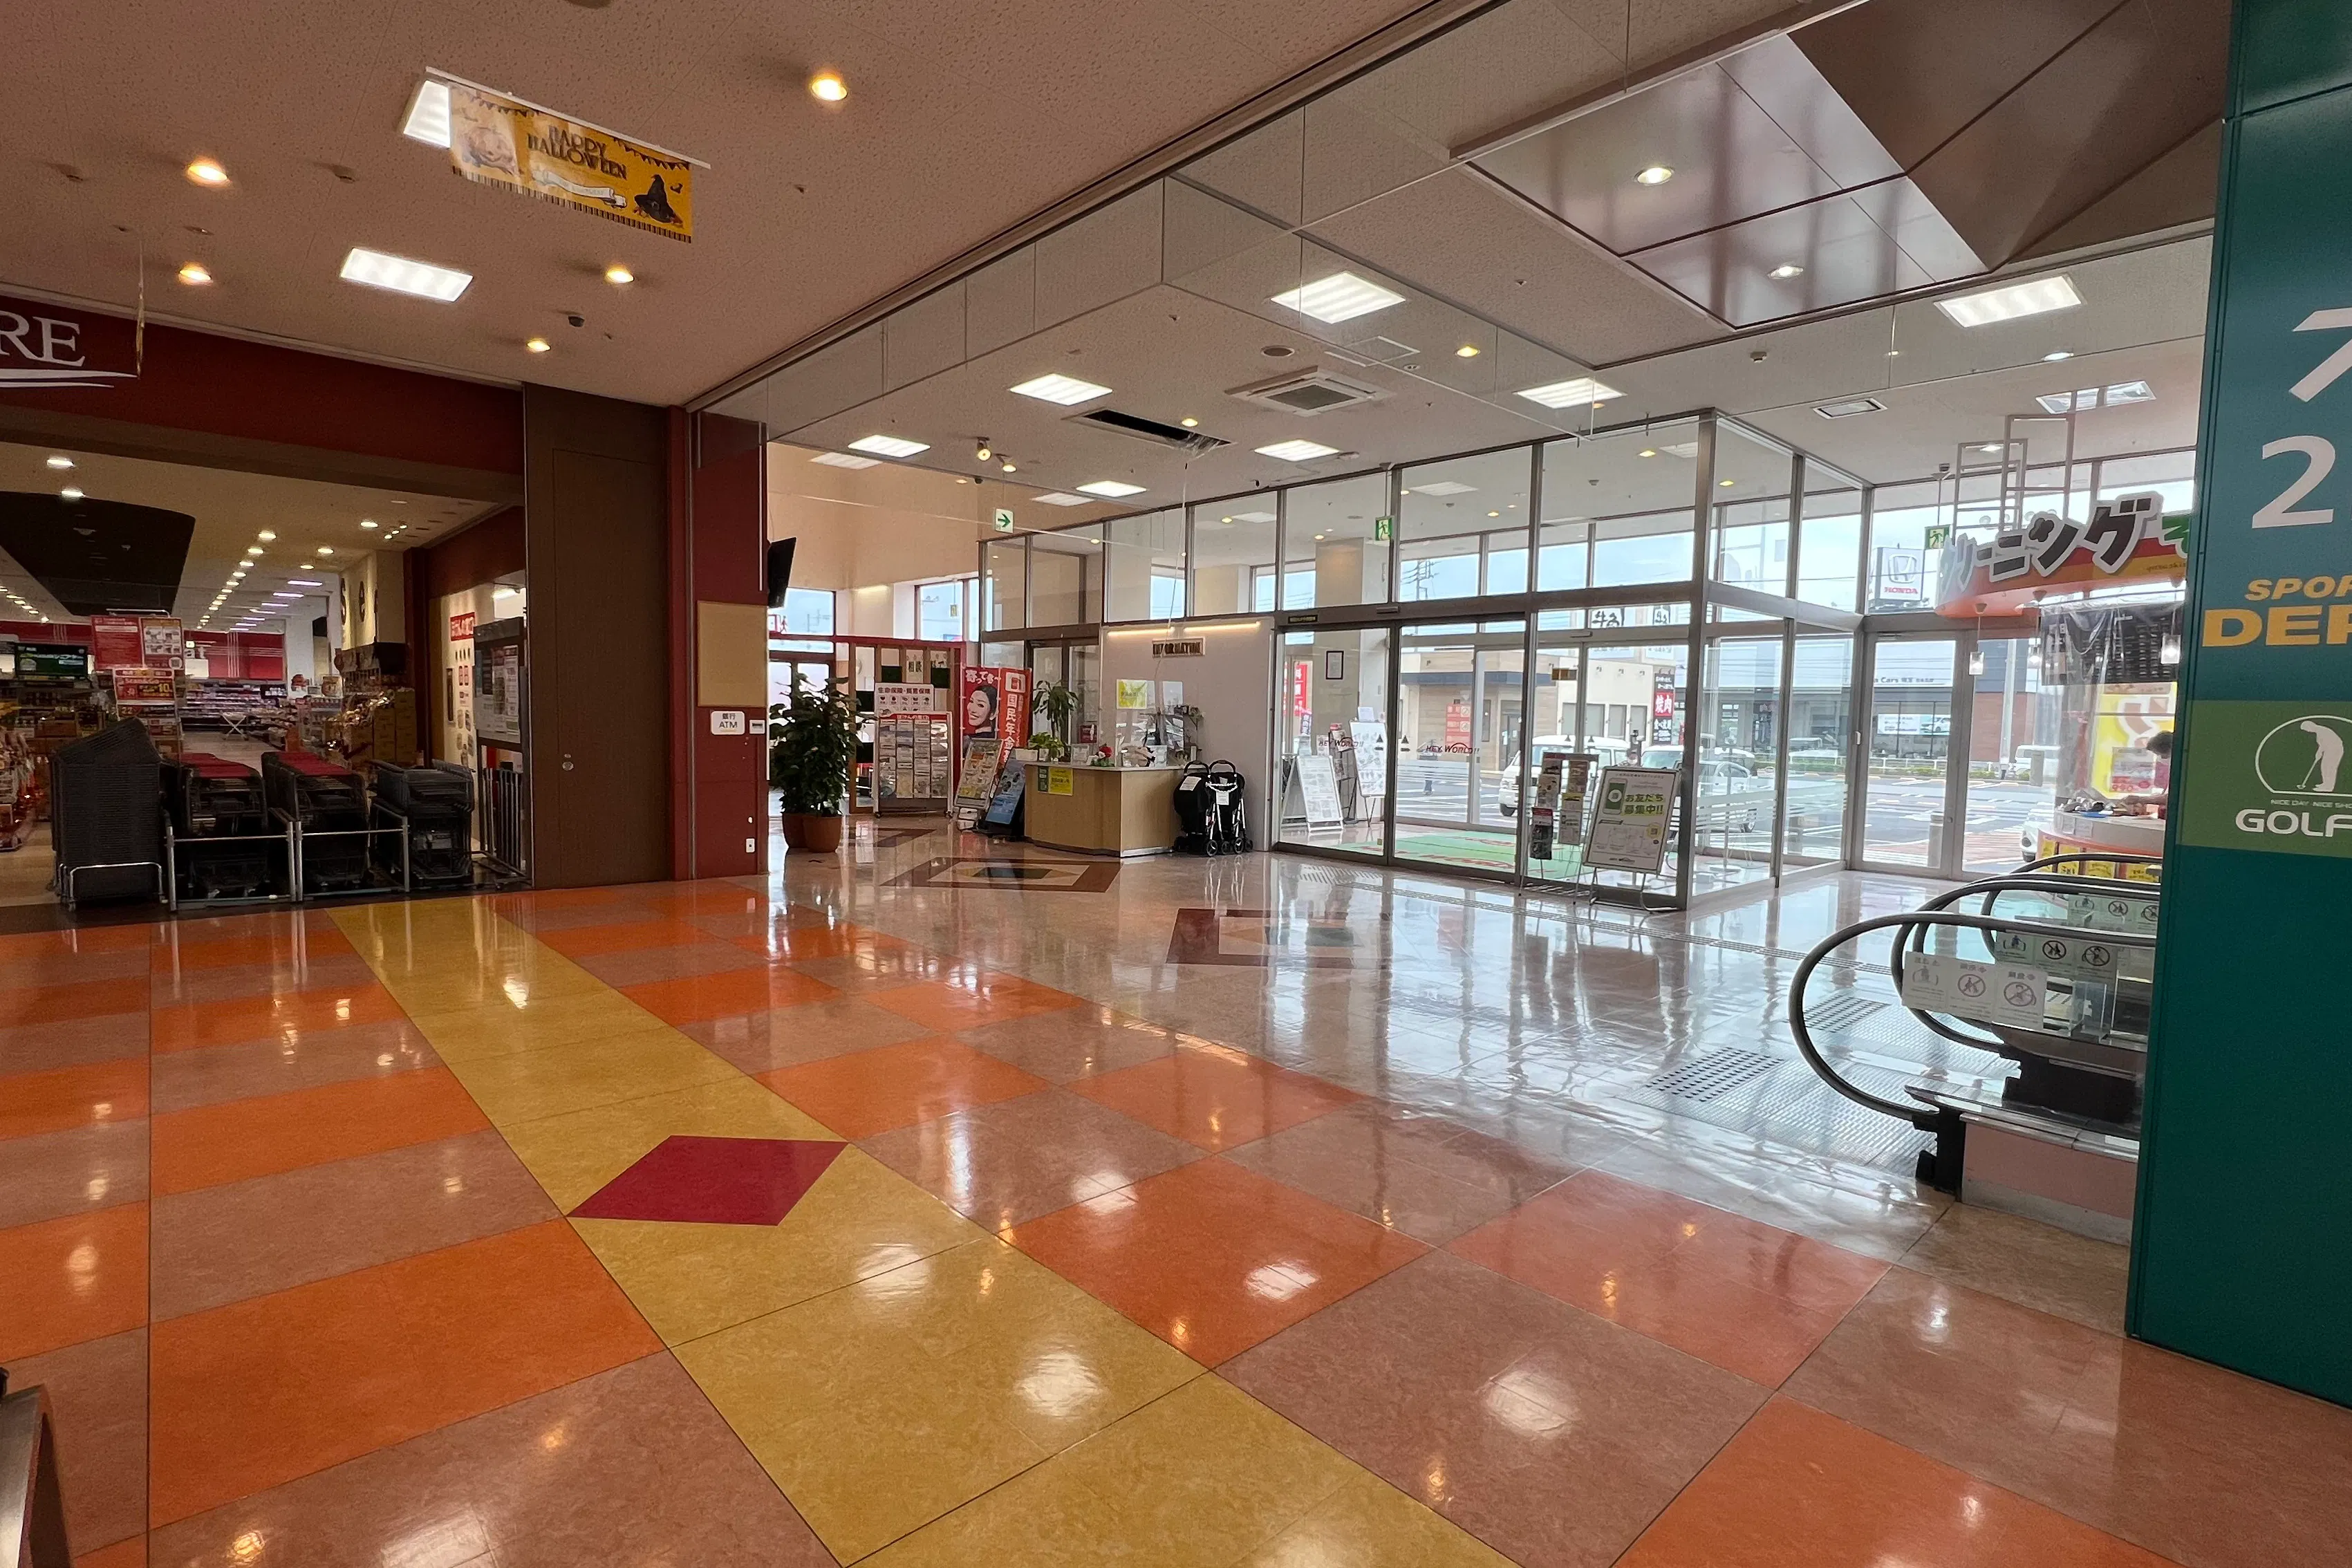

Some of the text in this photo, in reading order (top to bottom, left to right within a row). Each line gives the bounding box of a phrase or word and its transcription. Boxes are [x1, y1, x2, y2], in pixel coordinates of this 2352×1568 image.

[1625, 793, 1663, 803] お友だち
[1624, 804, 1663, 815] 募集中!!
[2236, 808, 2352, 837] GOLF
